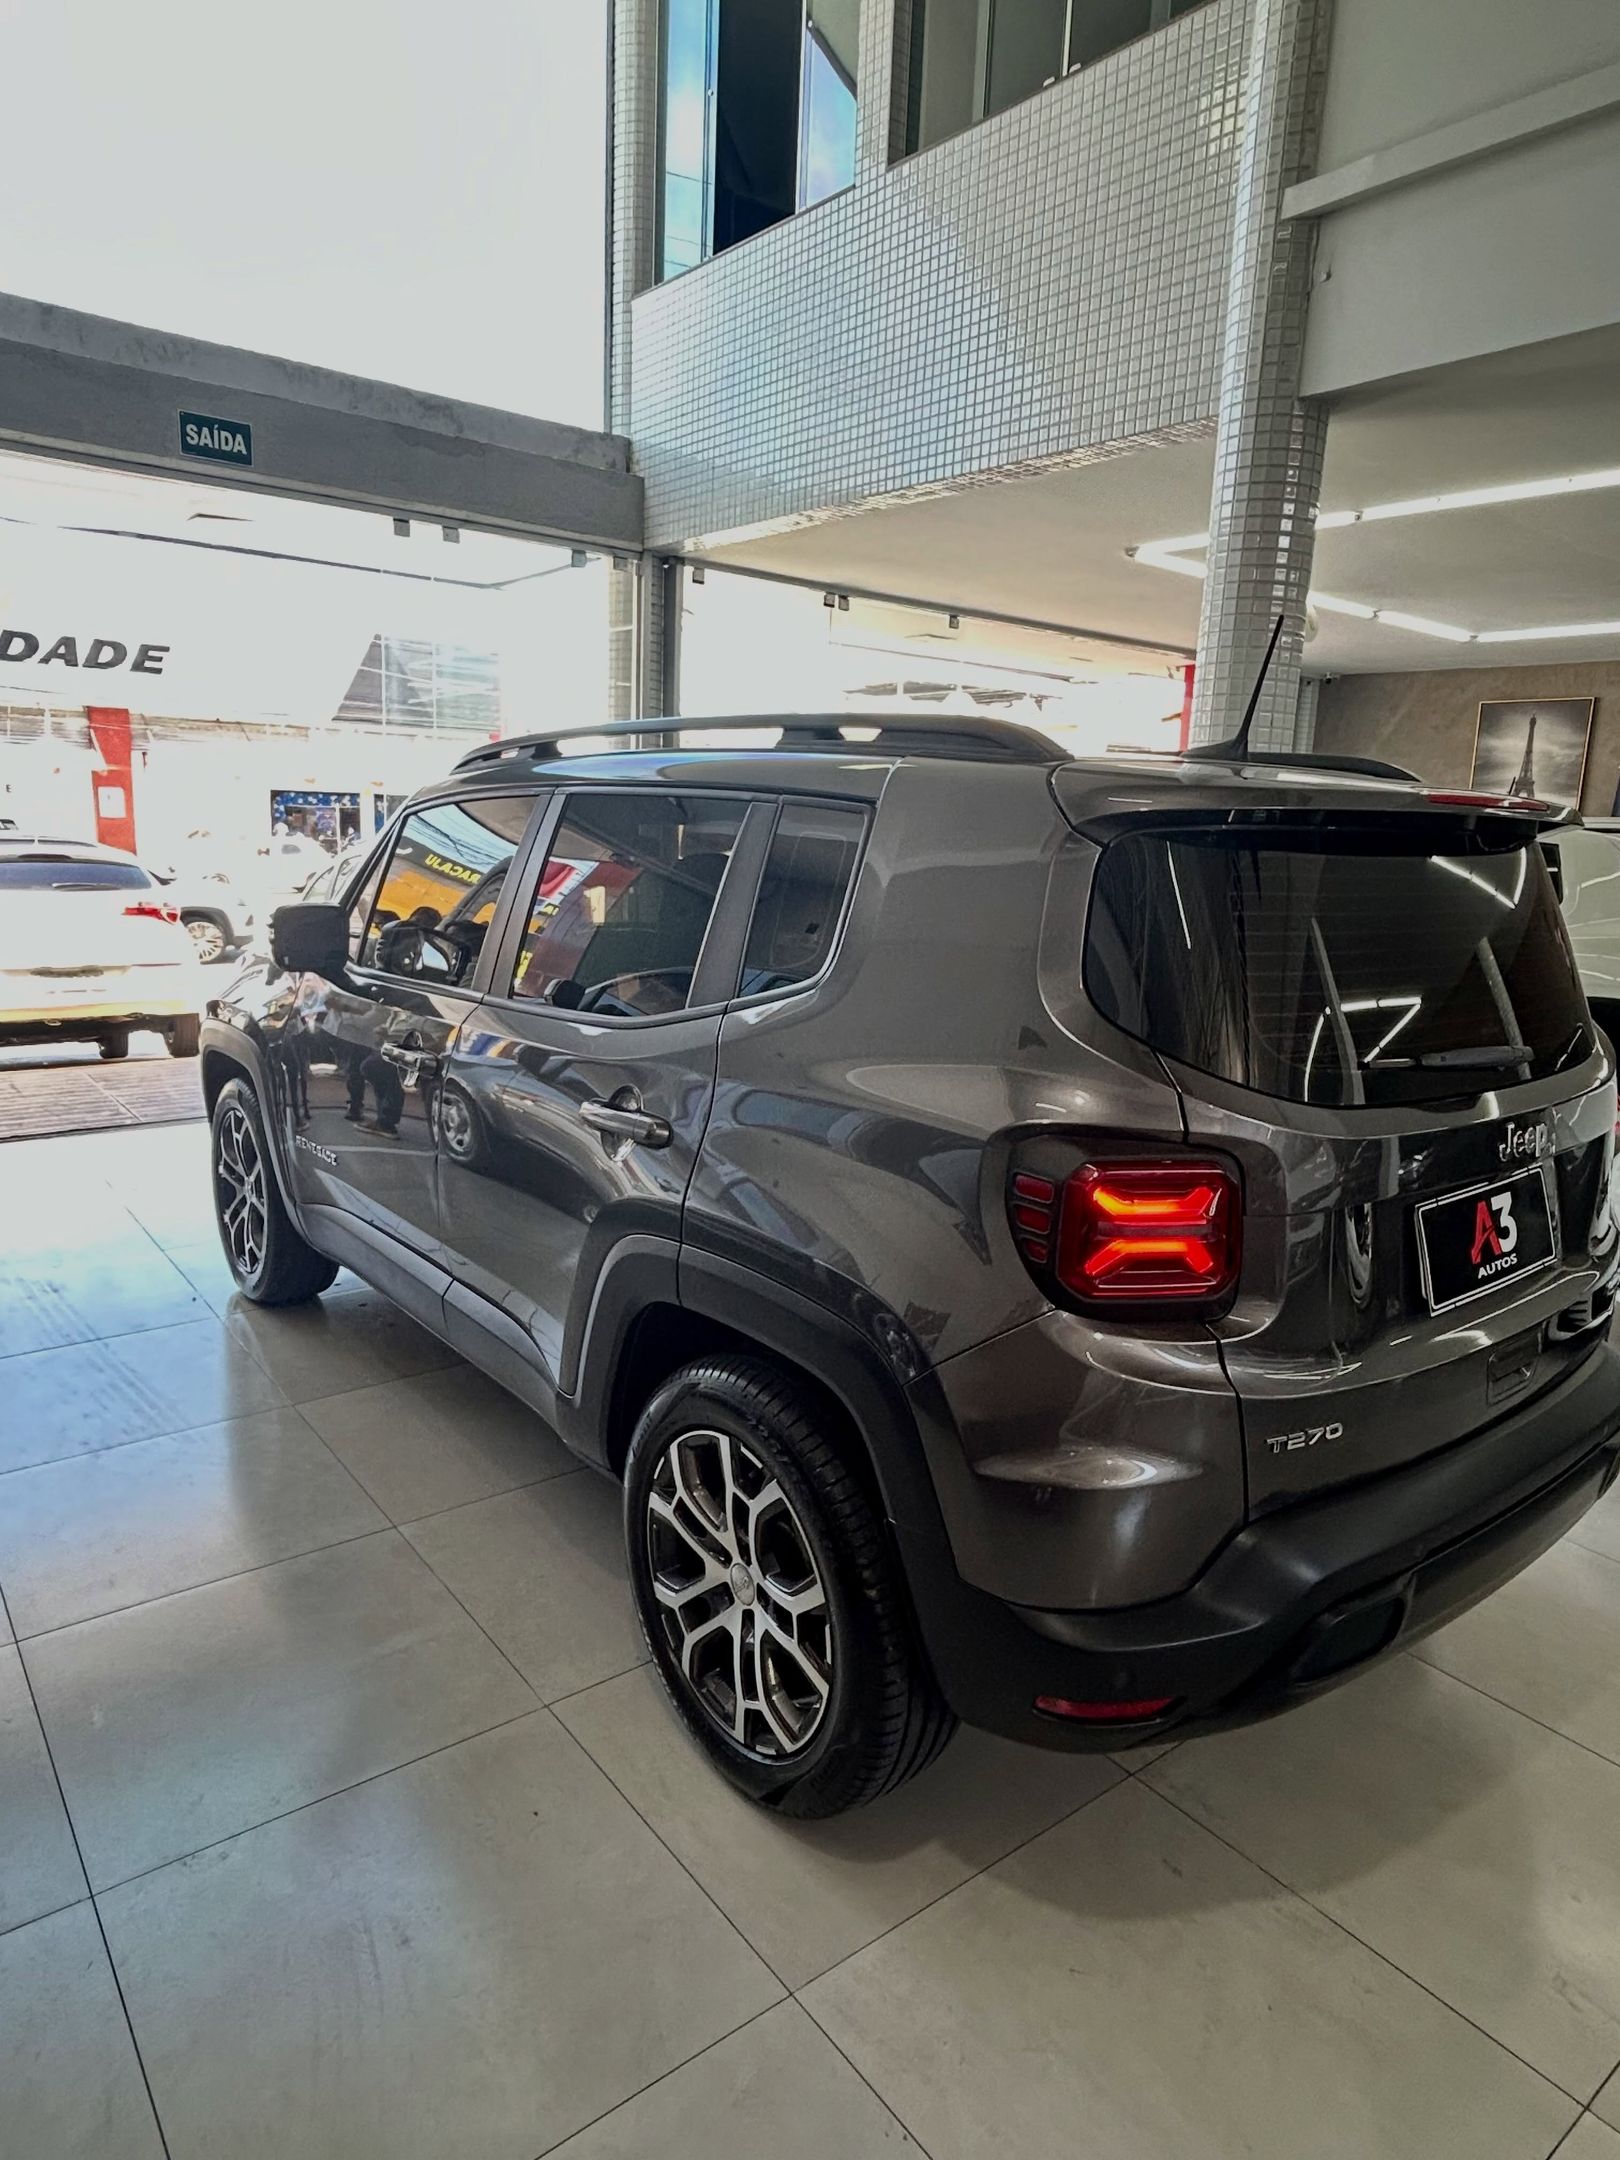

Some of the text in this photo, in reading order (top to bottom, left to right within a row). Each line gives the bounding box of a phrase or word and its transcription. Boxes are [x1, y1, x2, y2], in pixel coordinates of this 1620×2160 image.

[185, 423, 248, 456] SAÍDA
[0, 628, 171, 675] DADE
[1499, 1121, 1550, 1162] Jeep
[1471, 1191, 1518, 1265] A3
[1477, 1252, 1518, 1280] AUTOS
[1266, 1422, 1344, 1454] T270
